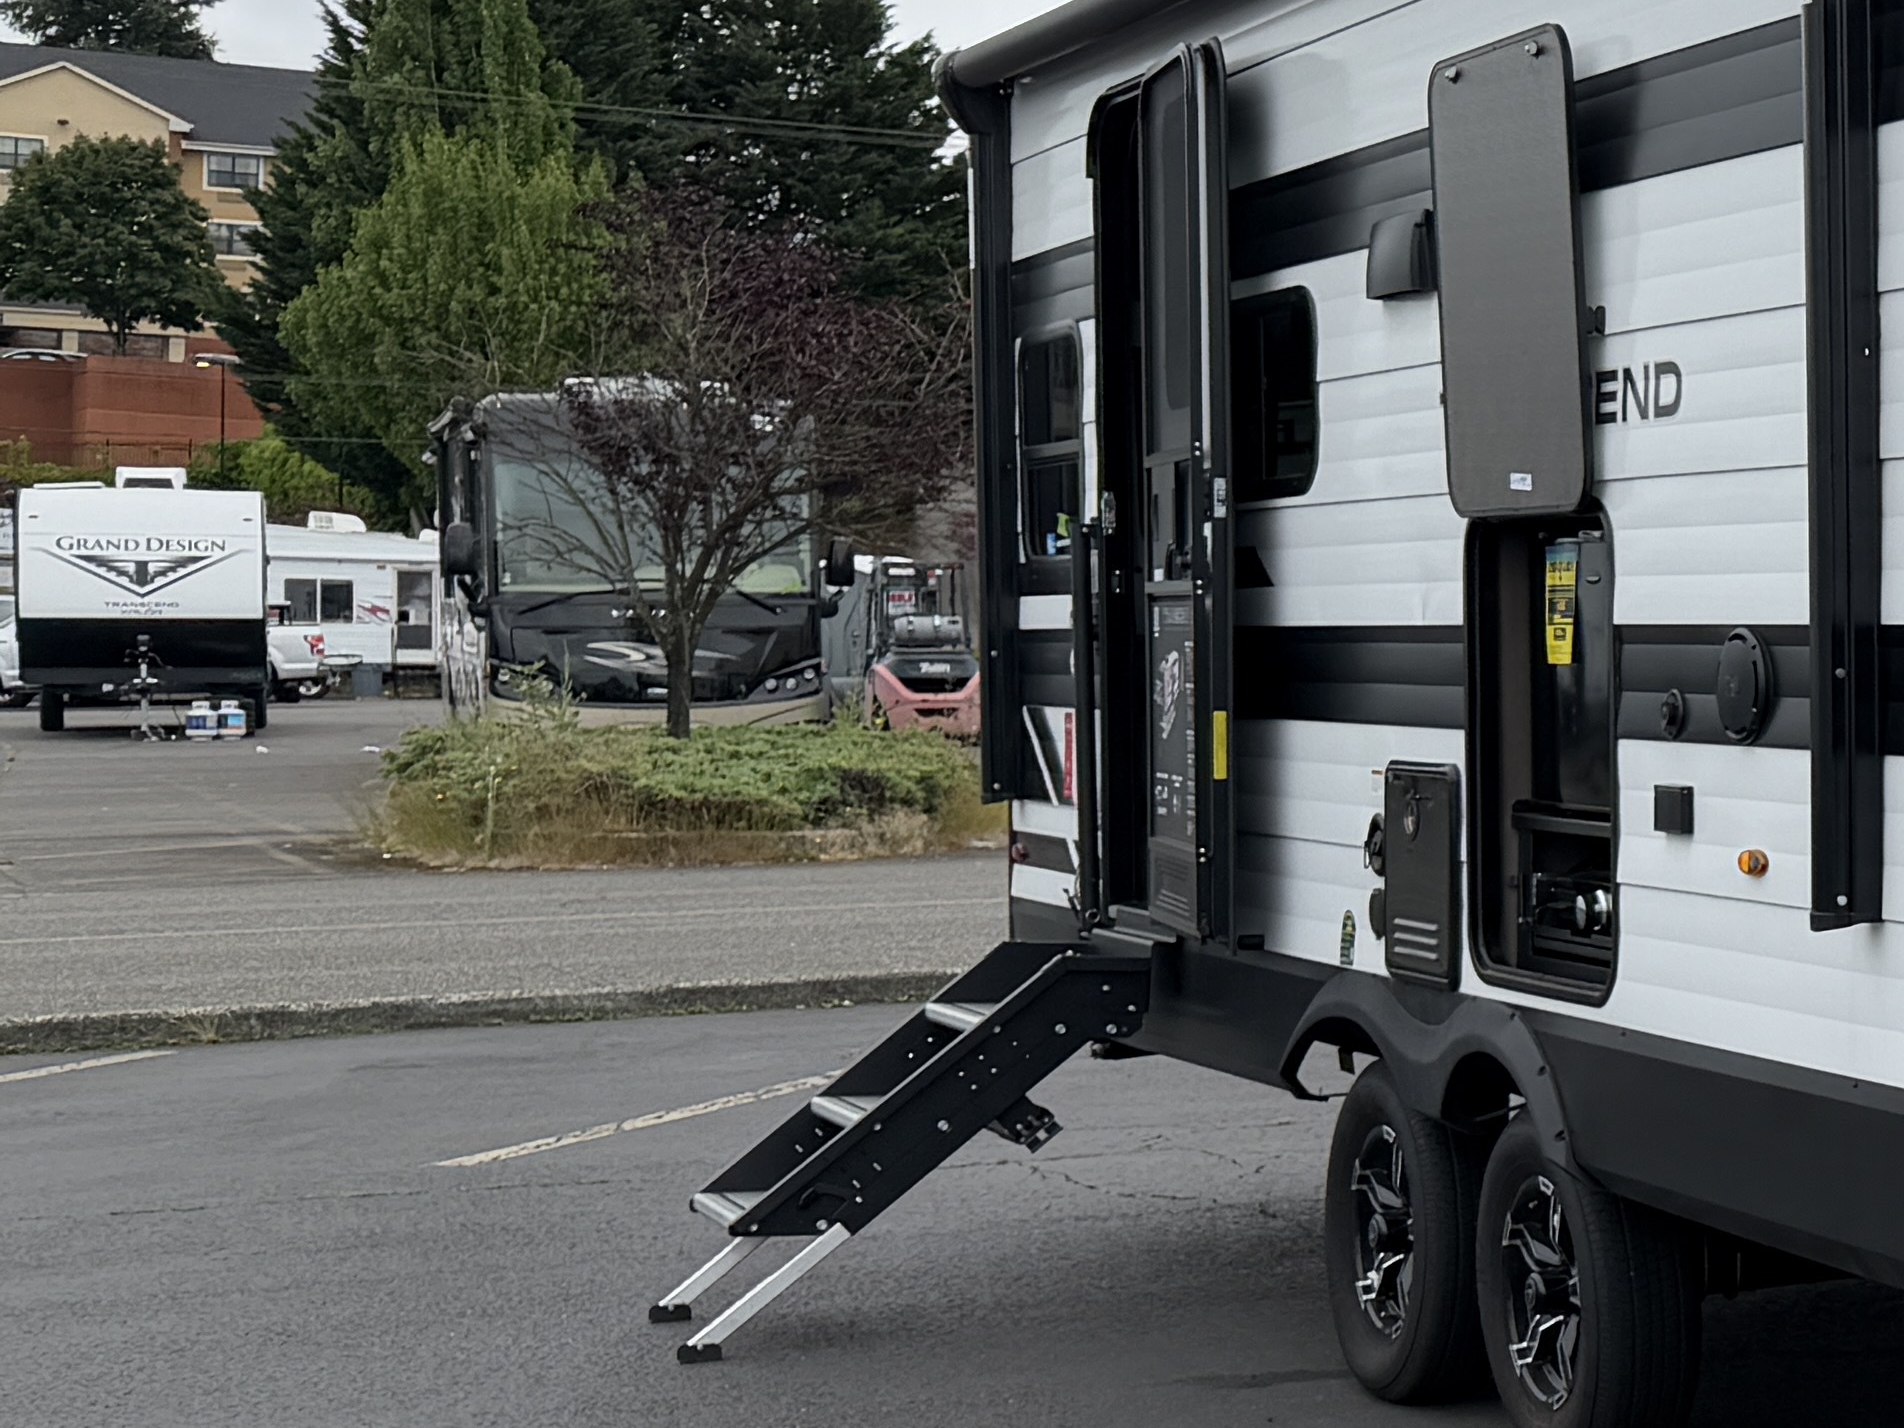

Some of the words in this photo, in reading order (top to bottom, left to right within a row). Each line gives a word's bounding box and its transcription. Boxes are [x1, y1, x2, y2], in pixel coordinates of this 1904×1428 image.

[1595, 361, 1682, 424] END
[55, 535, 140, 552] GRAND
[146, 537, 226, 552] DESIGN
